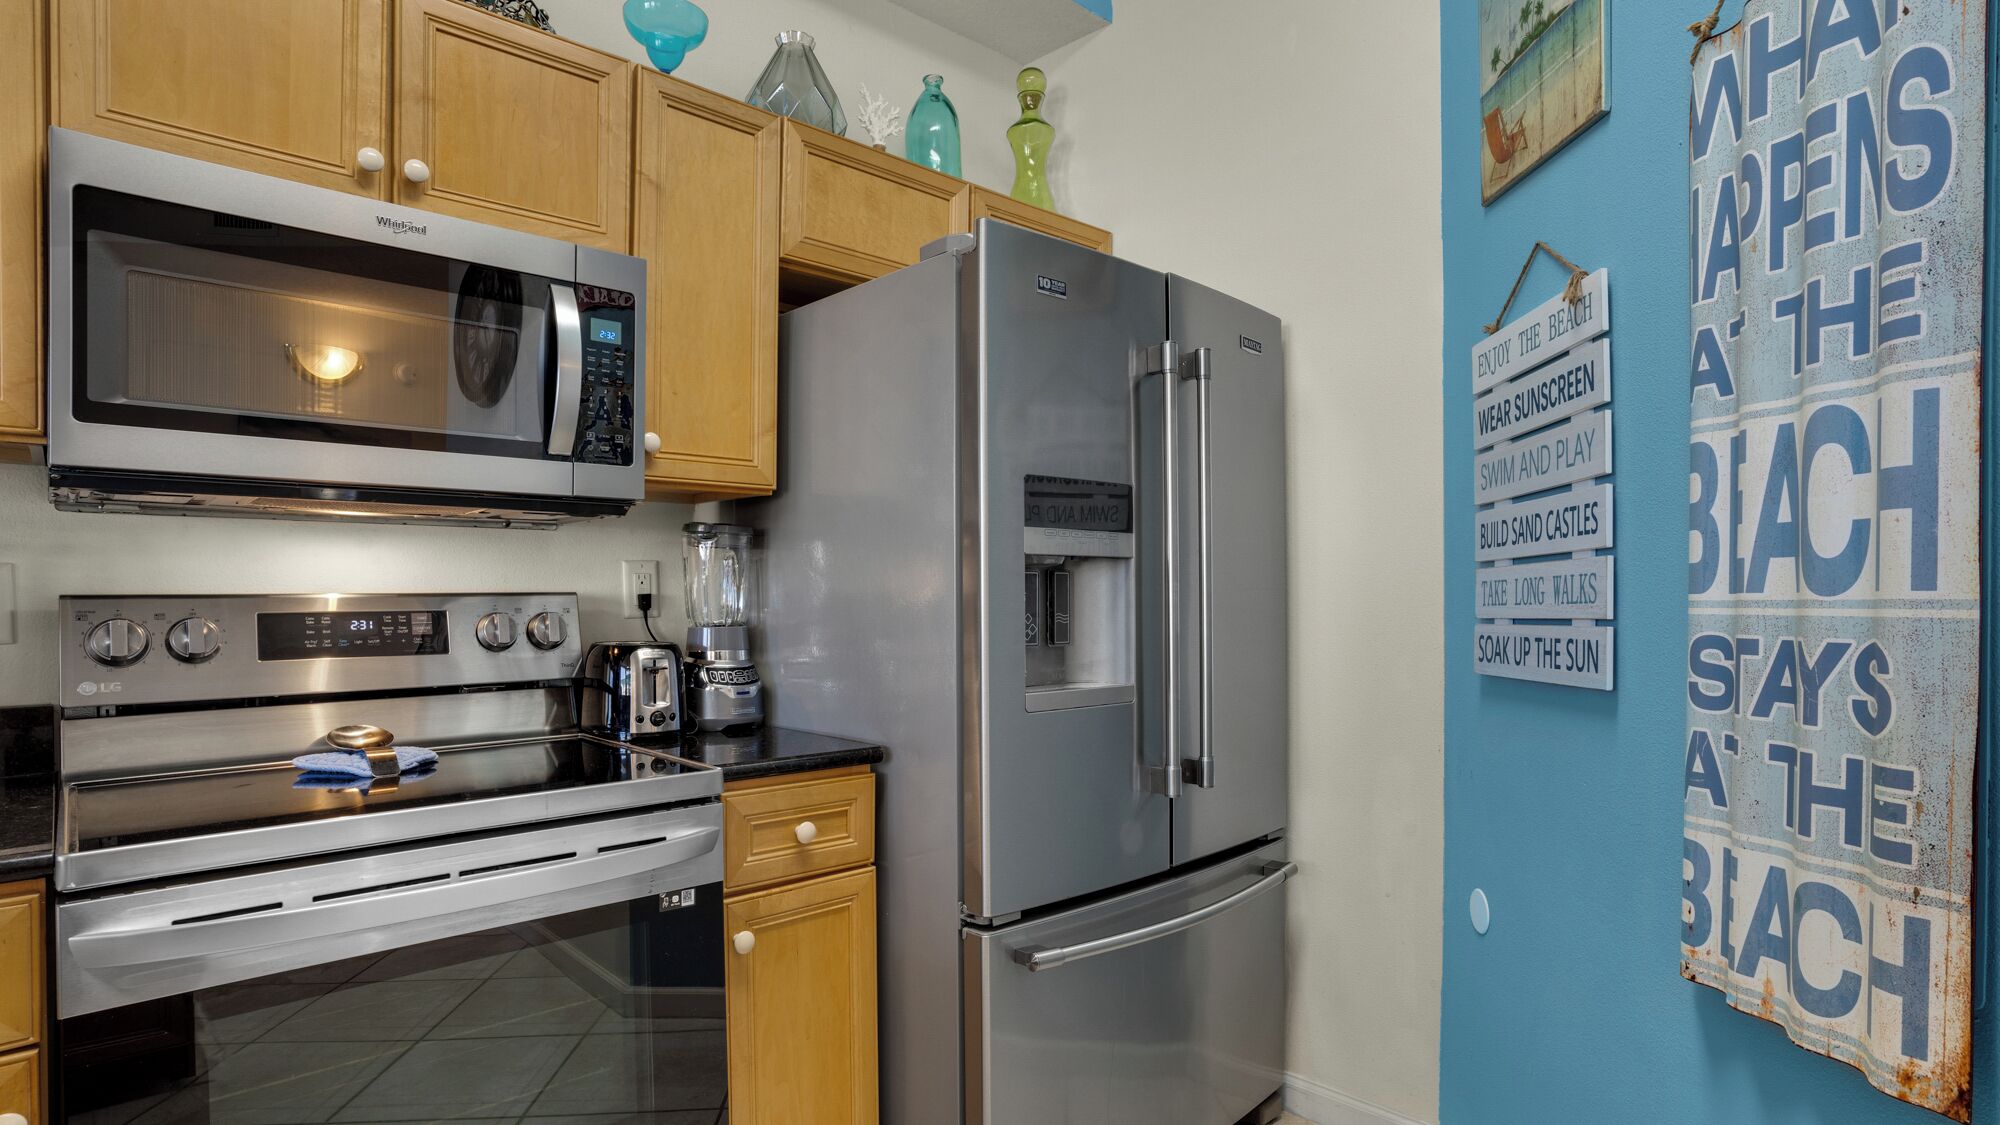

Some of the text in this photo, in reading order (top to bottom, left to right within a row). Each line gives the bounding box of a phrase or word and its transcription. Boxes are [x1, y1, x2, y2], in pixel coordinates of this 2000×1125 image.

[1691, 0, 1898, 162] WHA
[376, 215, 427, 235] Whirlpool
[1038, 276, 1051, 289] 10
[1773, 241, 1924, 378] THE
[599, 329, 616, 340] 2:32
[1478, 291, 1593, 378] ENJOY THE BEACH
[1478, 360, 1595, 436] WEAR SUNSCREEN
[1480, 427, 1595, 491] SWIM AND PLAY
[1689, 387, 1940, 597] BEACH
[1480, 501, 1599, 549] BUILD SAND CASTLES
[1481, 572, 1597, 607] TAKE LONG WALKS
[350, 620, 373, 631] 2:31
[1478, 634, 1599, 674] SOAK UP THE SUN
[100, 682, 122, 693] LG
[1688, 634, 1892, 737] STAYS
[1767, 742, 1916, 866] THE
[1681, 837, 1932, 1062] BEACH
